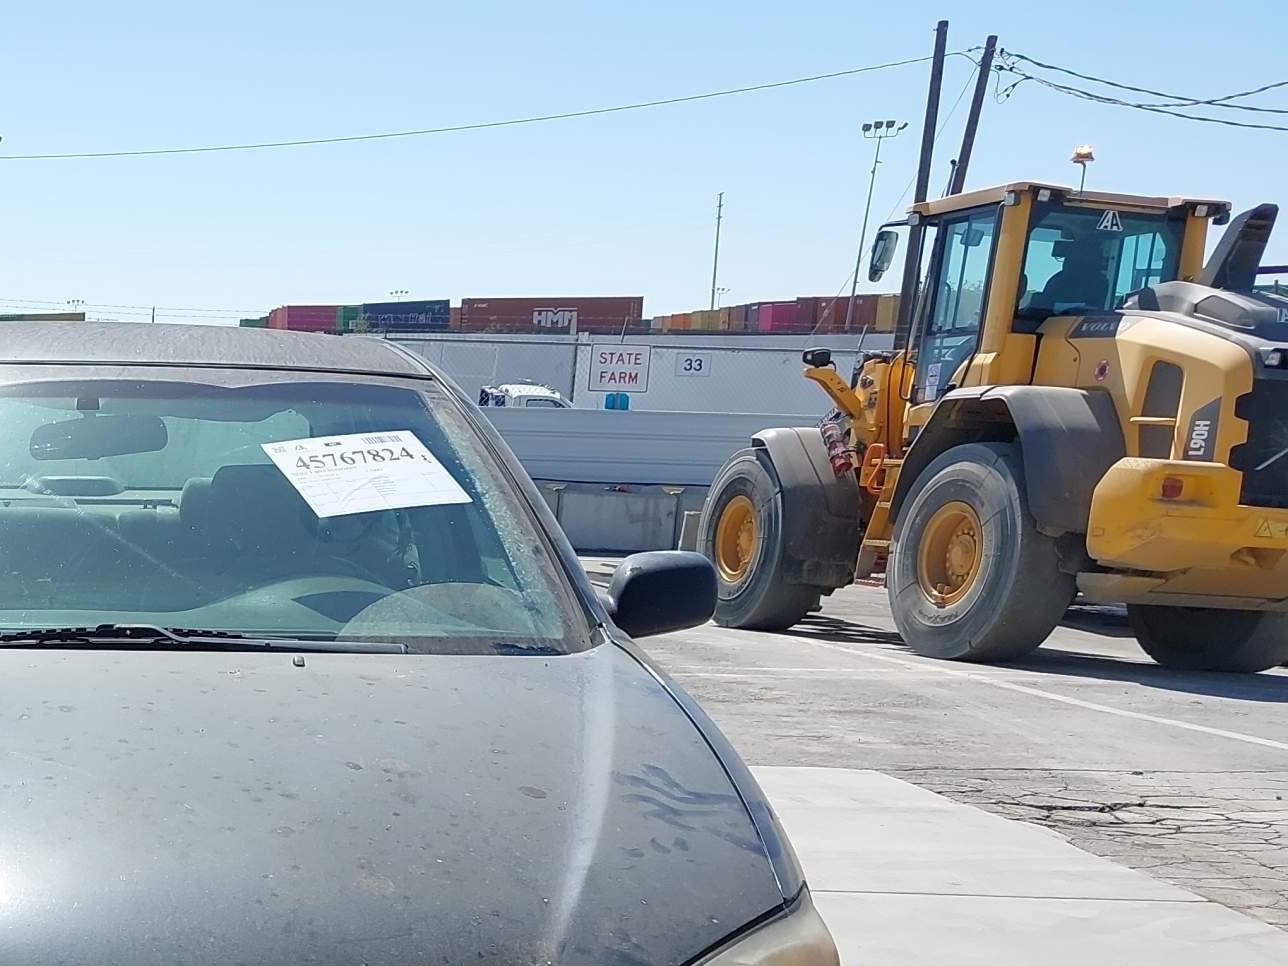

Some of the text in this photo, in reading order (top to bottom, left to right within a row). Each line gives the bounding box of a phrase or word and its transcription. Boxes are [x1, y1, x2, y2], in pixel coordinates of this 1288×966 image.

[599, 352, 643, 366] STATE
[683, 358, 703, 372] 33
[599, 371, 639, 385] FARM
[1188, 420, 1211, 456] L90H
[295, 447, 415, 470] 45767824
